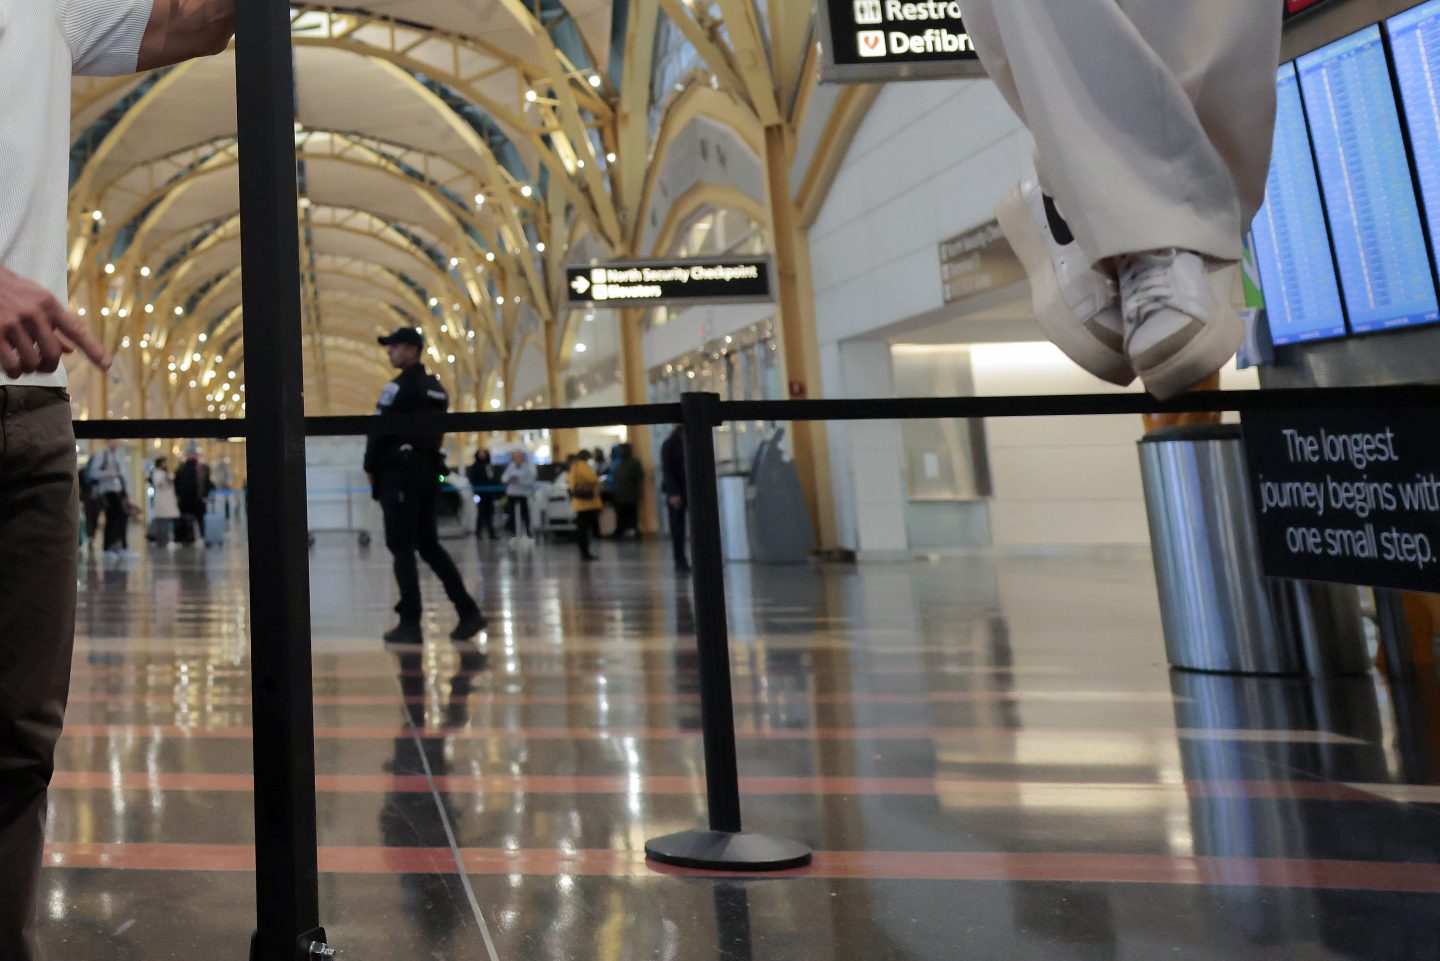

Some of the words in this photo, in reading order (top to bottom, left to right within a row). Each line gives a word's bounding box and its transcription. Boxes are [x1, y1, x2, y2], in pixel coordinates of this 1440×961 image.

[690, 265, 758, 281] Checkpoint
[1282, 429, 1320, 462] The
[1320, 426, 1399, 469] longest
[1259, 474, 1324, 516] journey
[1326, 474, 1397, 518] begins
[1286, 527, 1323, 554] one
[1324, 523, 1378, 559] small
[1380, 526, 1437, 570] step.
